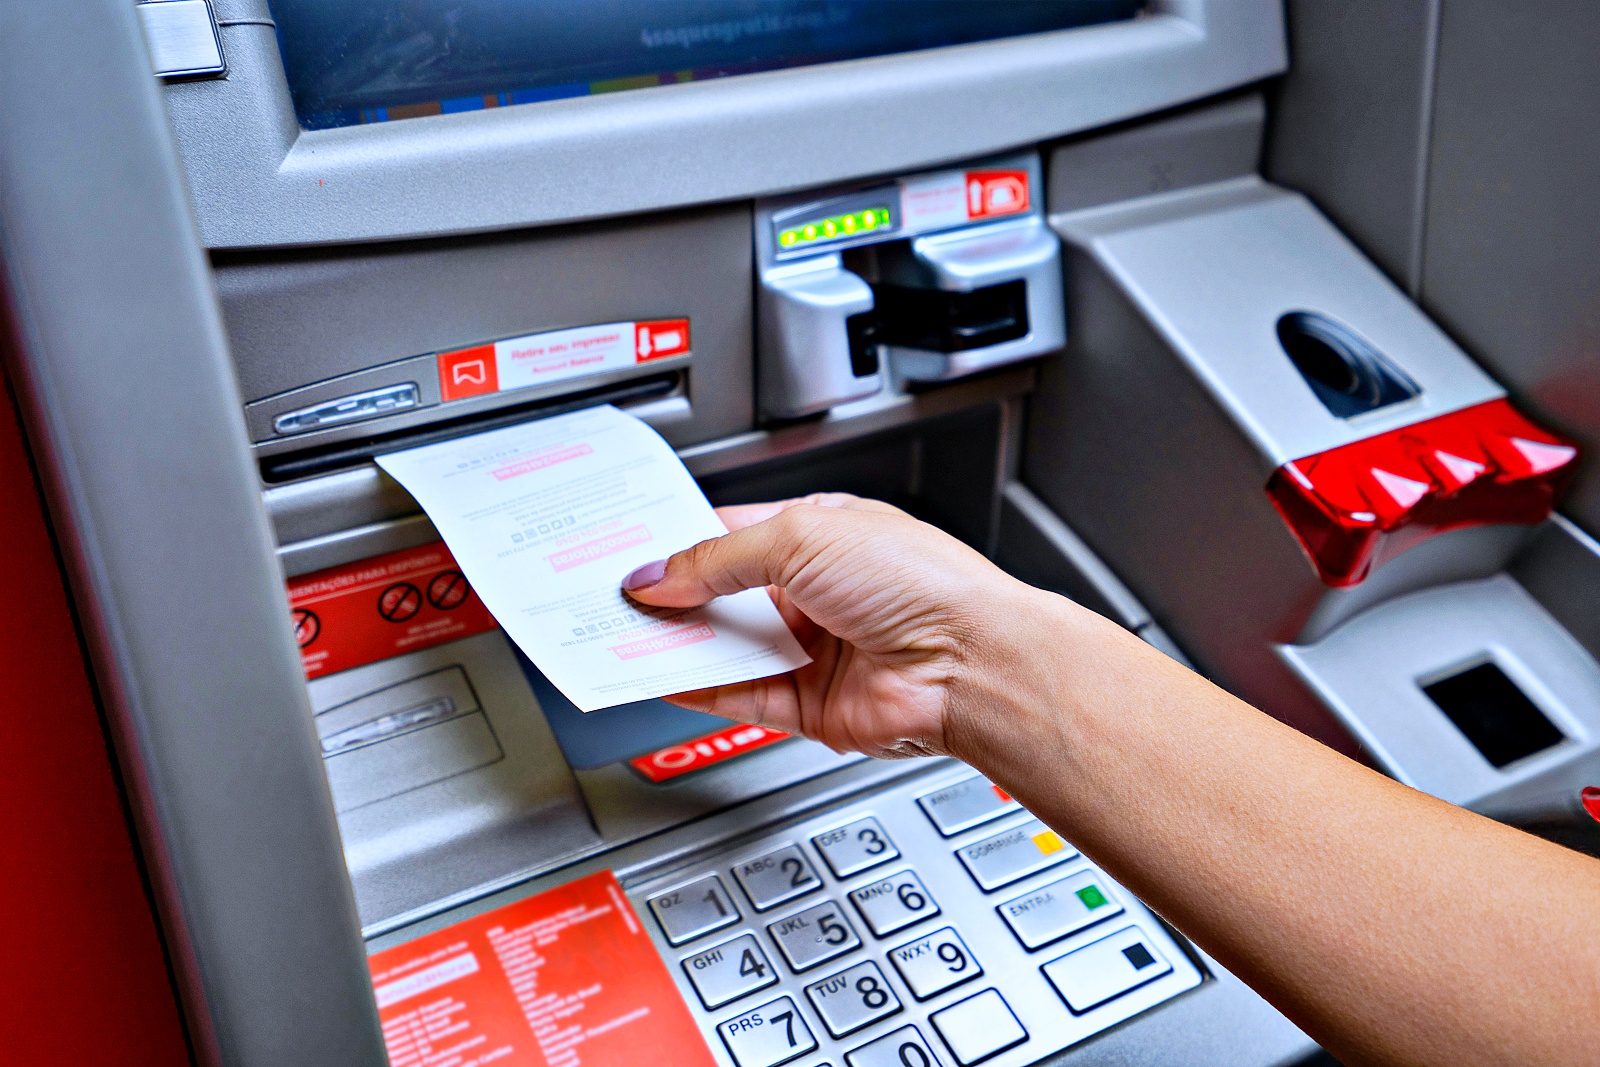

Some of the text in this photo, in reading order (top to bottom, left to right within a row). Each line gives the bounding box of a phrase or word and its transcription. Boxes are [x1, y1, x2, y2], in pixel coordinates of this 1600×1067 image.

[552, 526, 650, 568] Banco24Horas
[616, 625, 712, 657] Banco24Horas
[618, 629, 642, 642] 0240
[643, 624, 660, 635] 024
[820, 828, 887, 856] DEF 3
[743, 857, 813, 888] ABC 2
[659, 889, 728, 917] QZ 1
[856, 881, 927, 912] MNO 6
[1009, 893, 1054, 918] ENTRA
[780, 913, 849, 946] JKL 5
[693, 948, 766, 979] GHI 4
[897, 940, 968, 973] WXY 9
[814, 975, 889, 1010] TUV 8
[728, 1010, 798, 1048] PRS 7
[898, 1041, 931, 1067] 0
